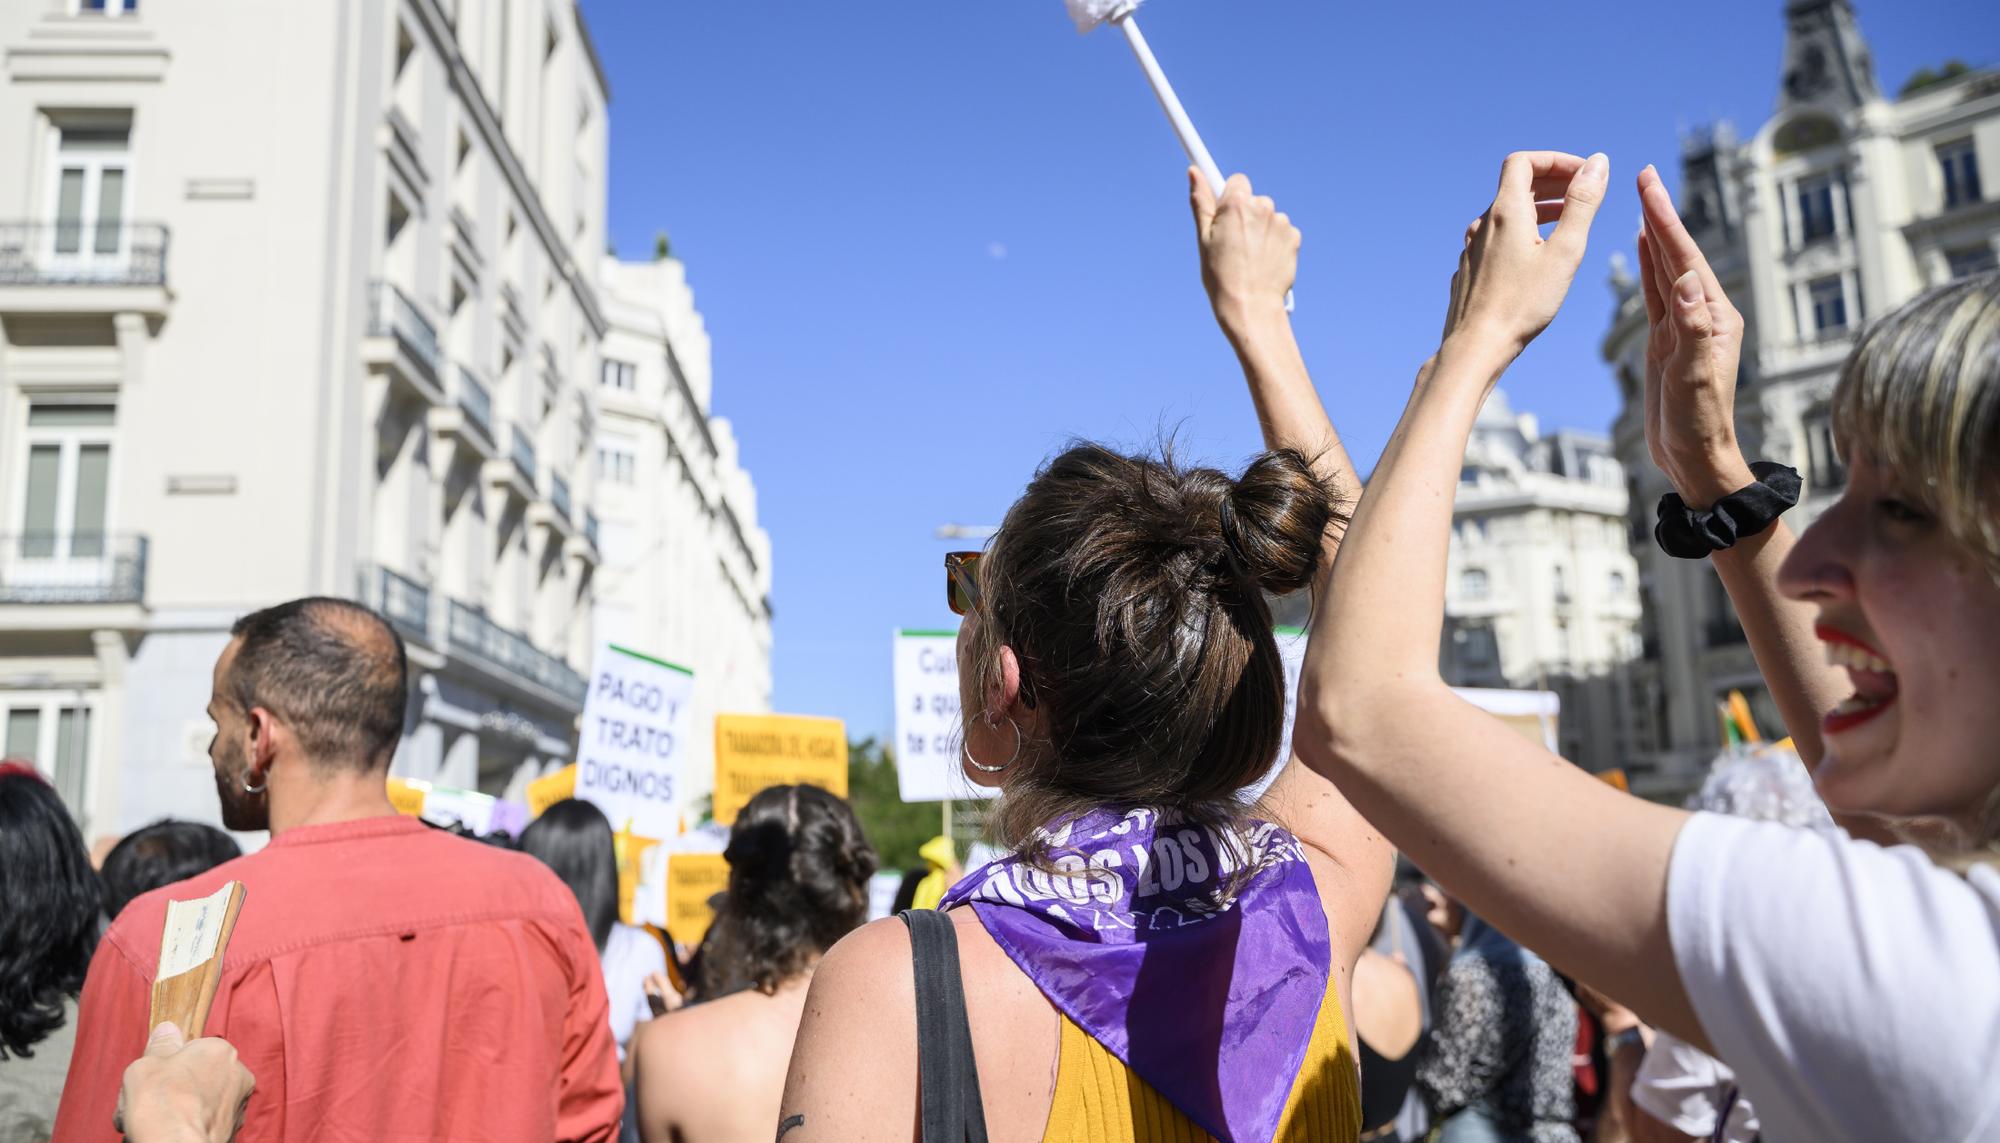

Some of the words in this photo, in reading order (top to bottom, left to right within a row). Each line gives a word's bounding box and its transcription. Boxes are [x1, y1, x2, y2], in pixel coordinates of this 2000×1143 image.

[597, 671, 663, 713] PAGO
[912, 696, 924, 715] a
[597, 714, 674, 758] TRATO
[907, 733, 925, 755] te
[970, 848, 1124, 907] ODOS
[1131, 829, 1210, 897] LOS
